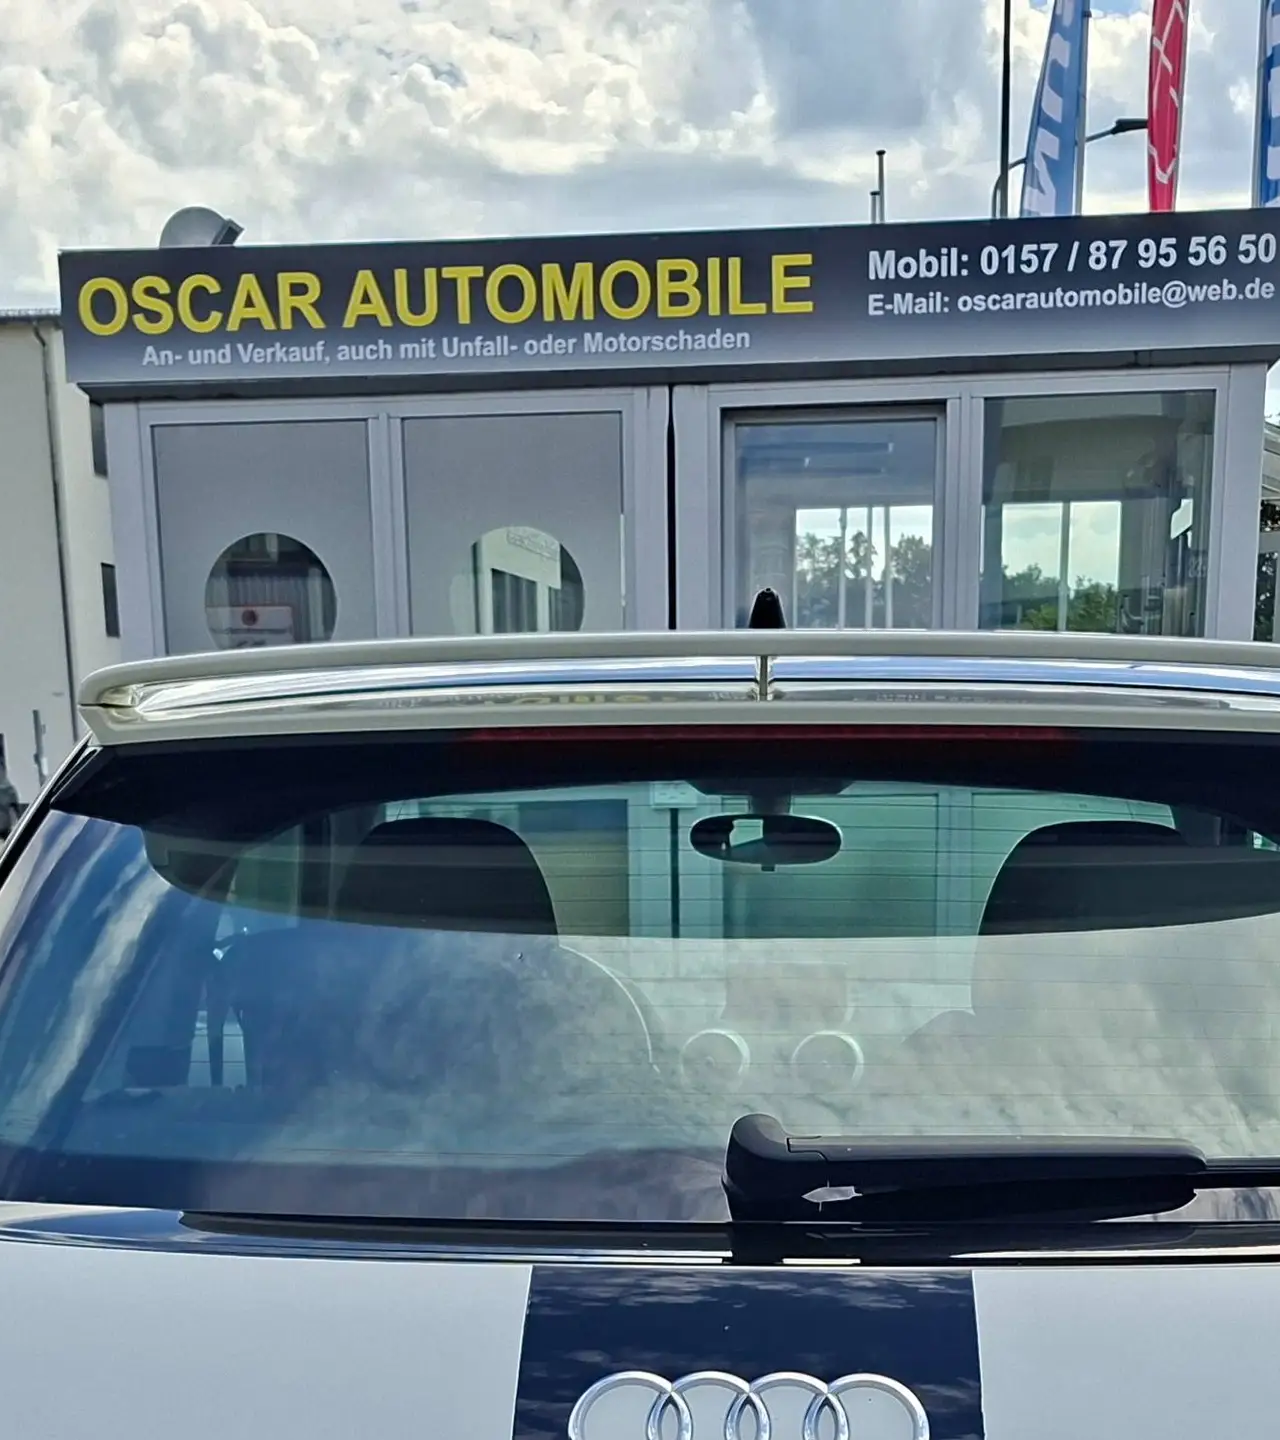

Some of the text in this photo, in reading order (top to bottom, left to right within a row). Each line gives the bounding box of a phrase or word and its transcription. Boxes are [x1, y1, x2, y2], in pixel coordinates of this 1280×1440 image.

[867, 232, 1278, 280] Mobil: 0157 / 87 95 56 50
[77, 252, 815, 336] OSCAR AUTOMOBILE
[867, 277, 1276, 317] E-Mail: oscarautomobile@web.de
[141, 328, 751, 367] An- und Verkauf, auch mit Unfall- oder Motorschaden
